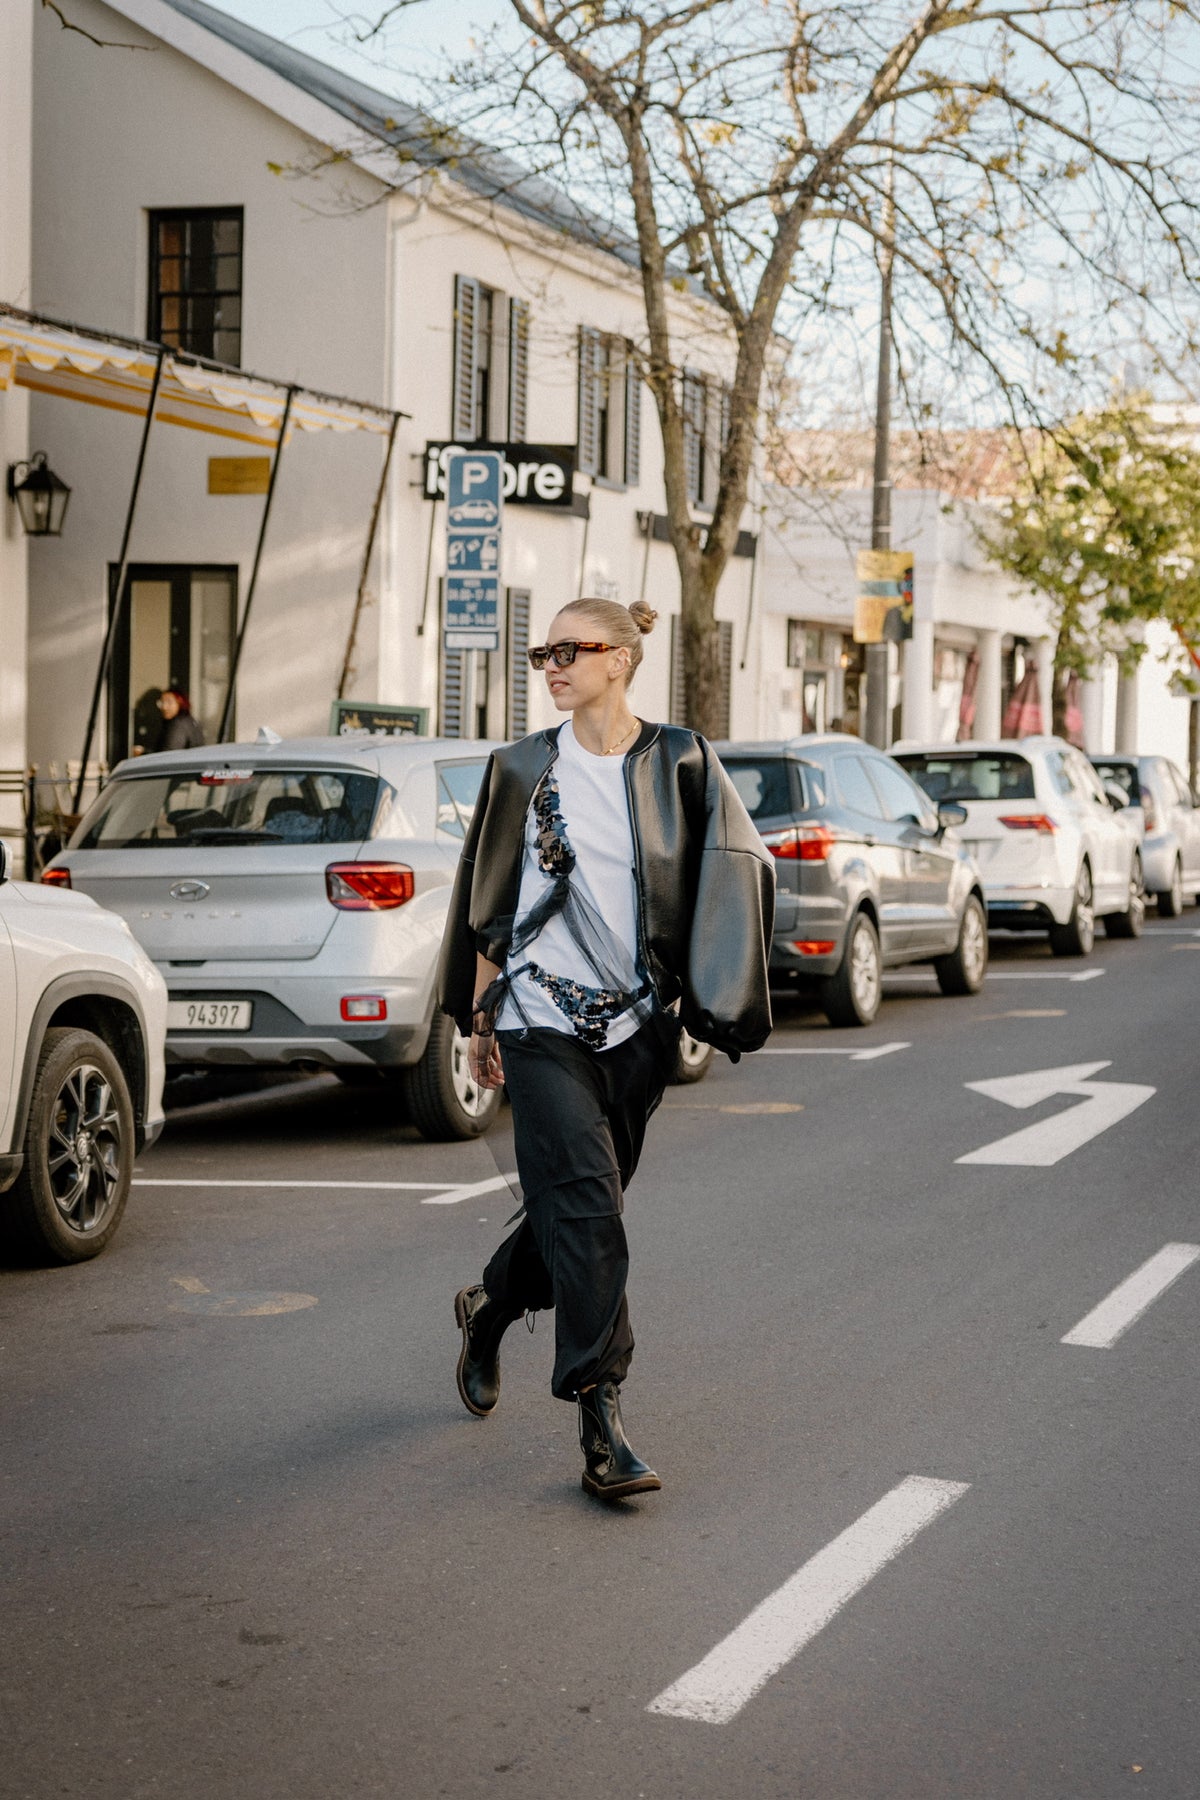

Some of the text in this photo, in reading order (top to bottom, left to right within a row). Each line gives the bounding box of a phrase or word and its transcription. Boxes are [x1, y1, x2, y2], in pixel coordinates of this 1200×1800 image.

[426, 445, 566, 500] ire
[462, 461, 490, 495] P
[187, 1004, 240, 1025] 94397
